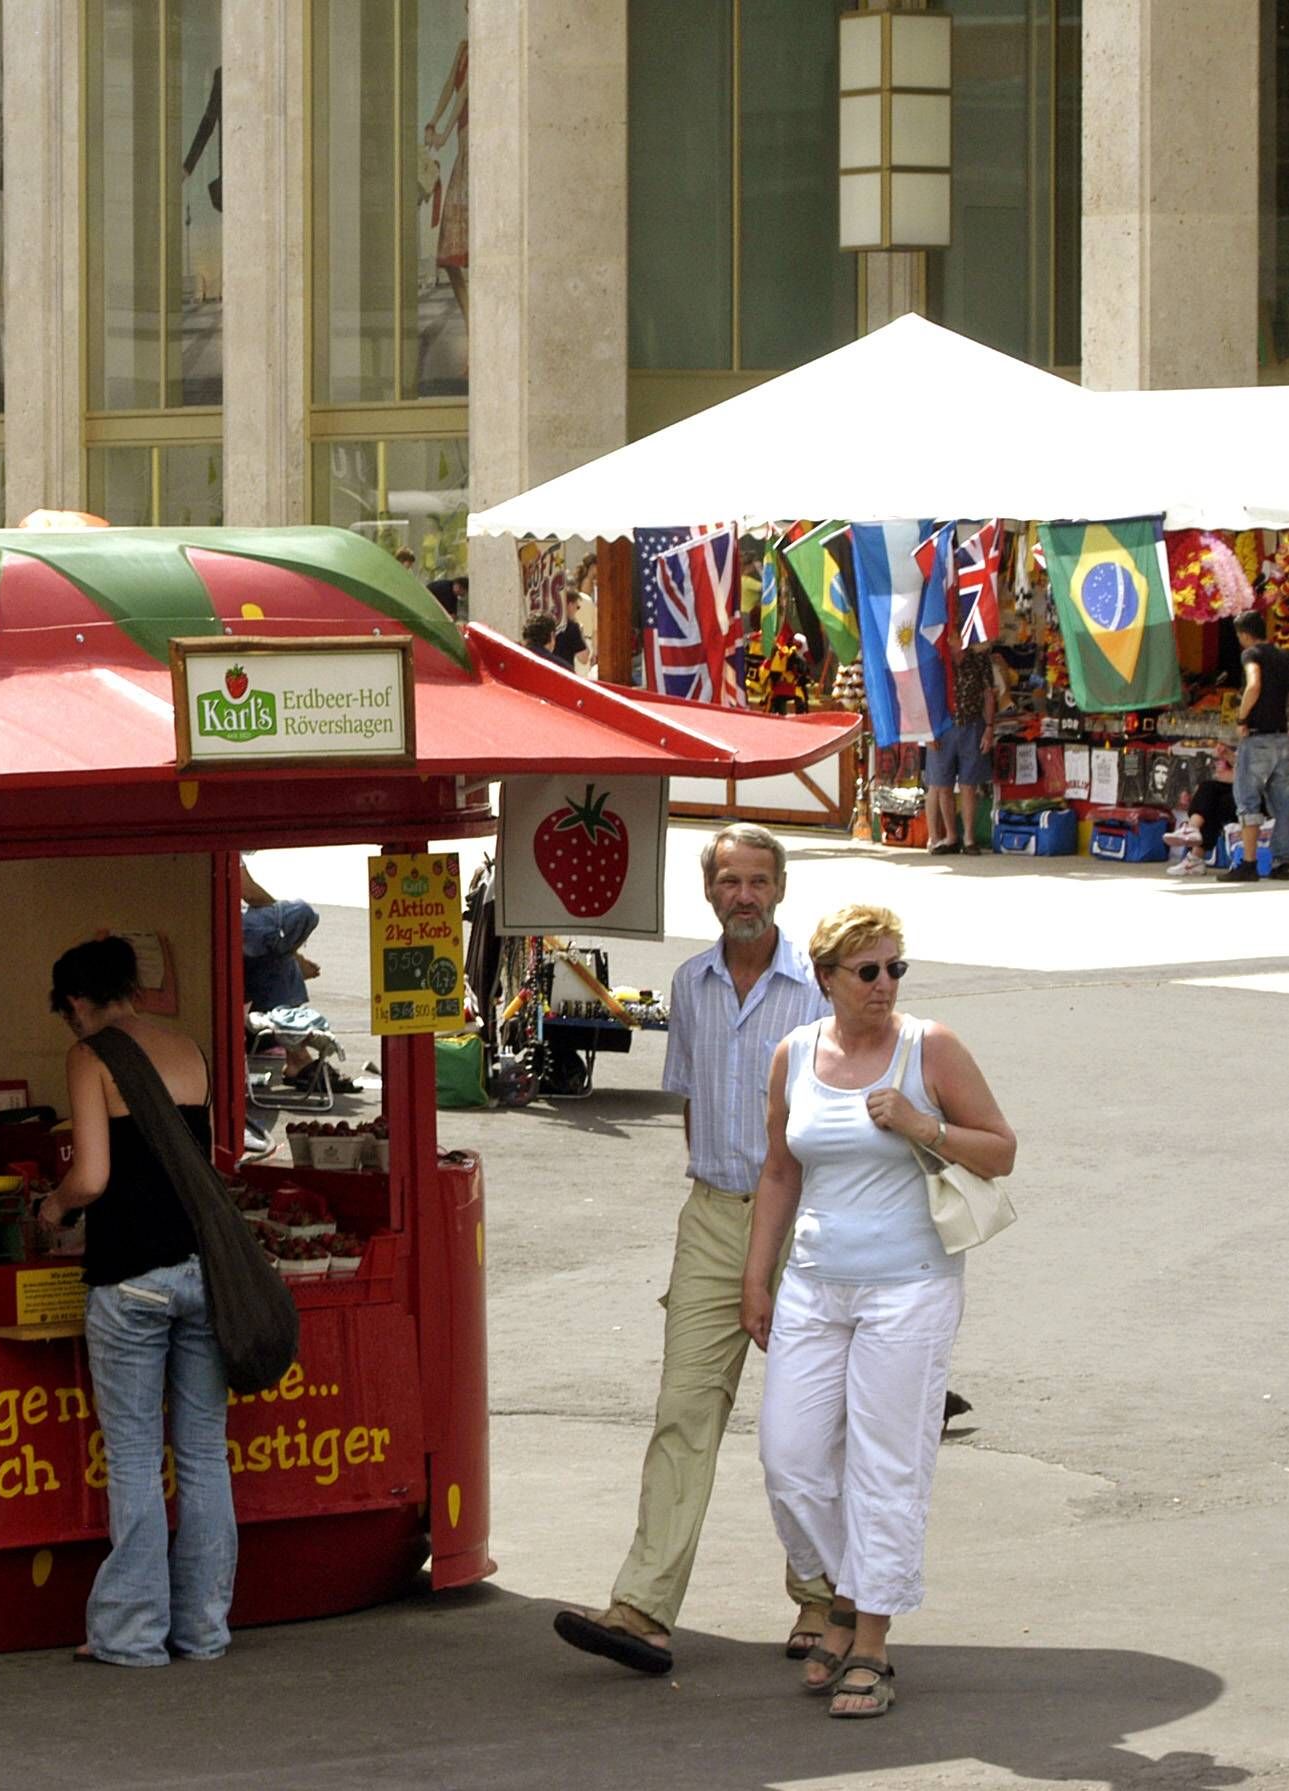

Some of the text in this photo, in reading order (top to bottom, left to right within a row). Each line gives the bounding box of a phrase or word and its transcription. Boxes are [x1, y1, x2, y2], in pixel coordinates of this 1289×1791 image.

[283, 686, 392, 709] Erdbeer-Hof
[202, 697, 272, 731] Karl's
[284, 714, 393, 738] Rövershagen
[388, 899, 445, 918] Aktion
[385, 921, 452, 945] 2kg-Korb
